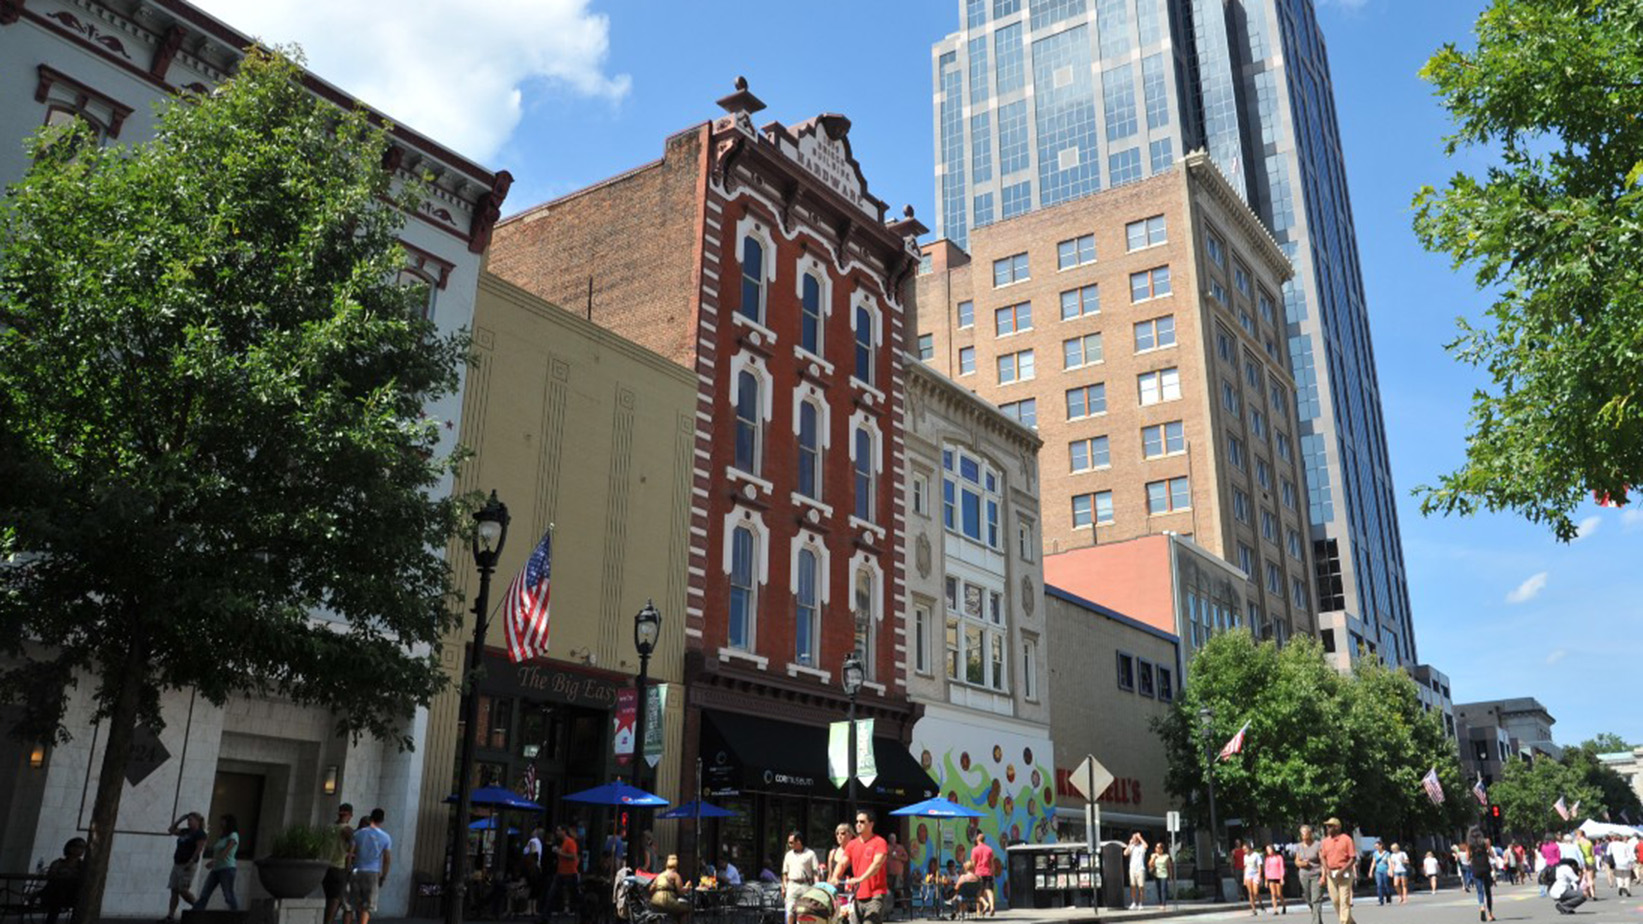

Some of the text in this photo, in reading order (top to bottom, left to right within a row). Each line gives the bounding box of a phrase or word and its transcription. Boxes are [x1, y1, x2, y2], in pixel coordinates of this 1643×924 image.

[812, 147, 850, 181] BUILDING
[817, 141, 845, 167] BRIGGS
[798, 152, 863, 208] HARDWARE
[517, 665, 618, 708] The Big Easy
[1056, 768, 1141, 805] KIELL'S
